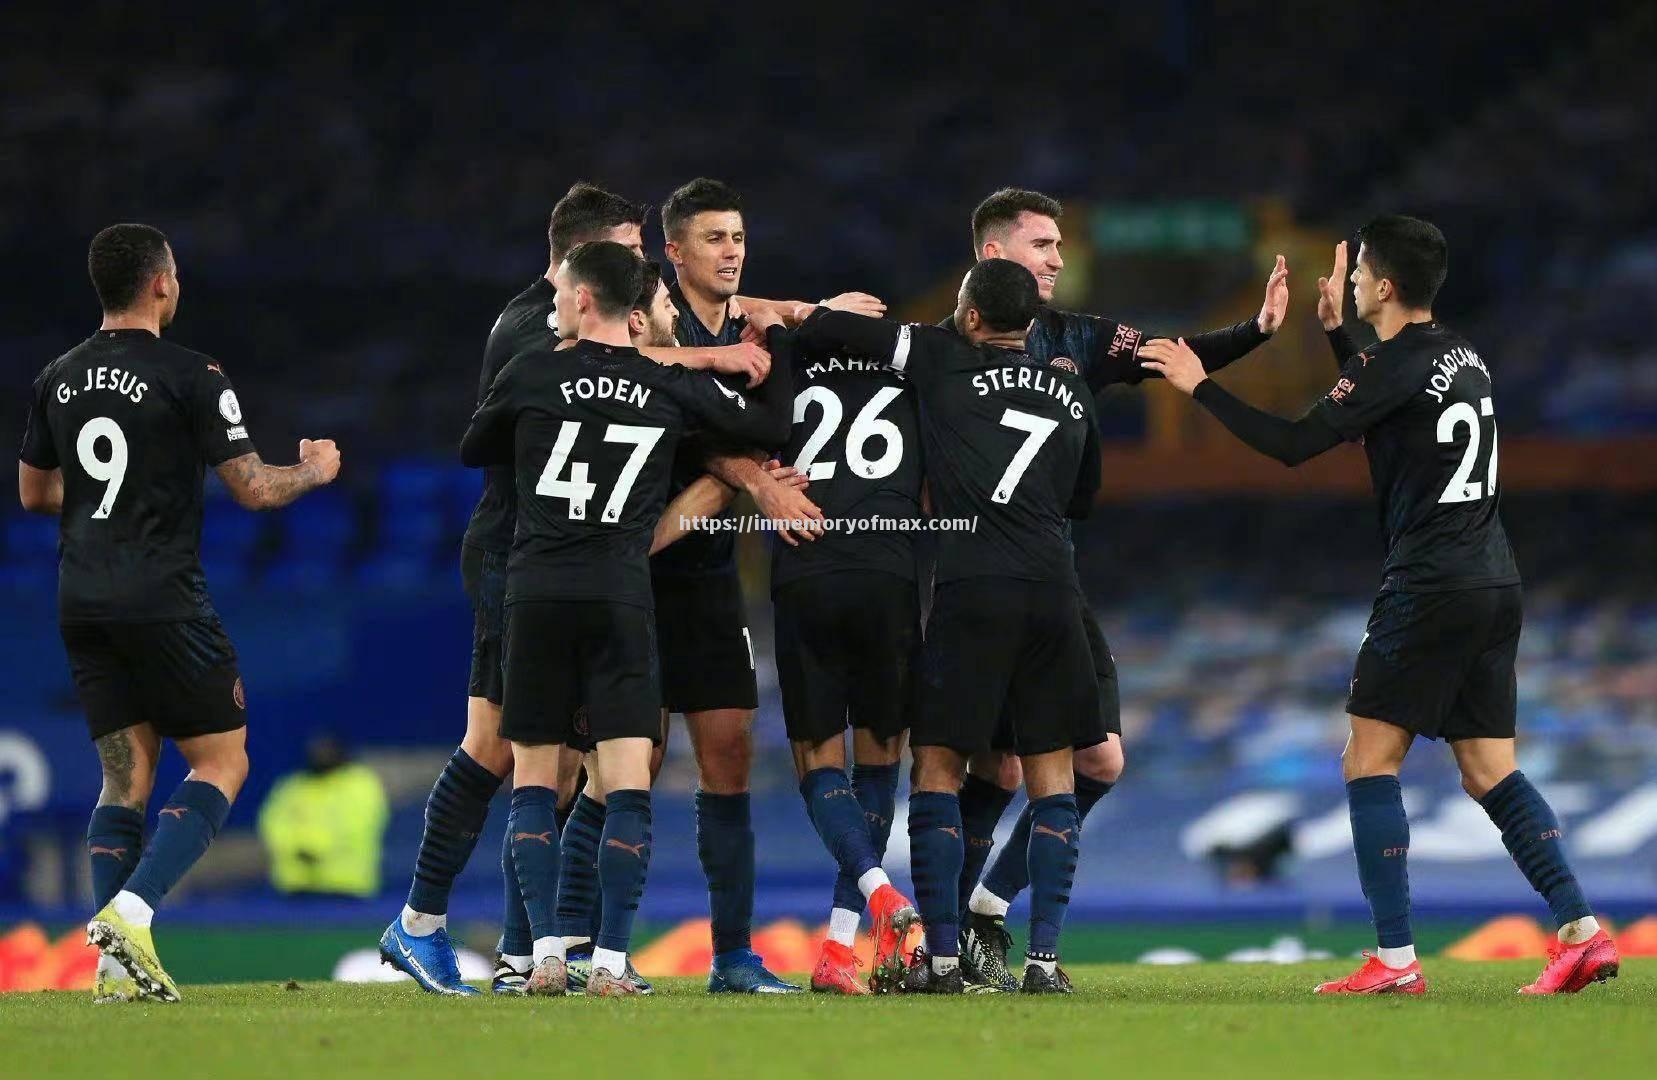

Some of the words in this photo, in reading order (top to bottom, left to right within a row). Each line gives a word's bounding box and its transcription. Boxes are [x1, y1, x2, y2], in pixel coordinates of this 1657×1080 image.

[1121, 328, 1139, 351] TIR
[57, 383, 77, 403] G.
[84, 367, 148, 403] JESUS
[560, 377, 651, 408] FODEN
[972, 367, 1083, 421] STERLING
[76, 417, 128, 519] 9
[792, 386, 904, 481] 26
[991, 408, 1059, 504] 7
[536, 421, 665, 523] 47
